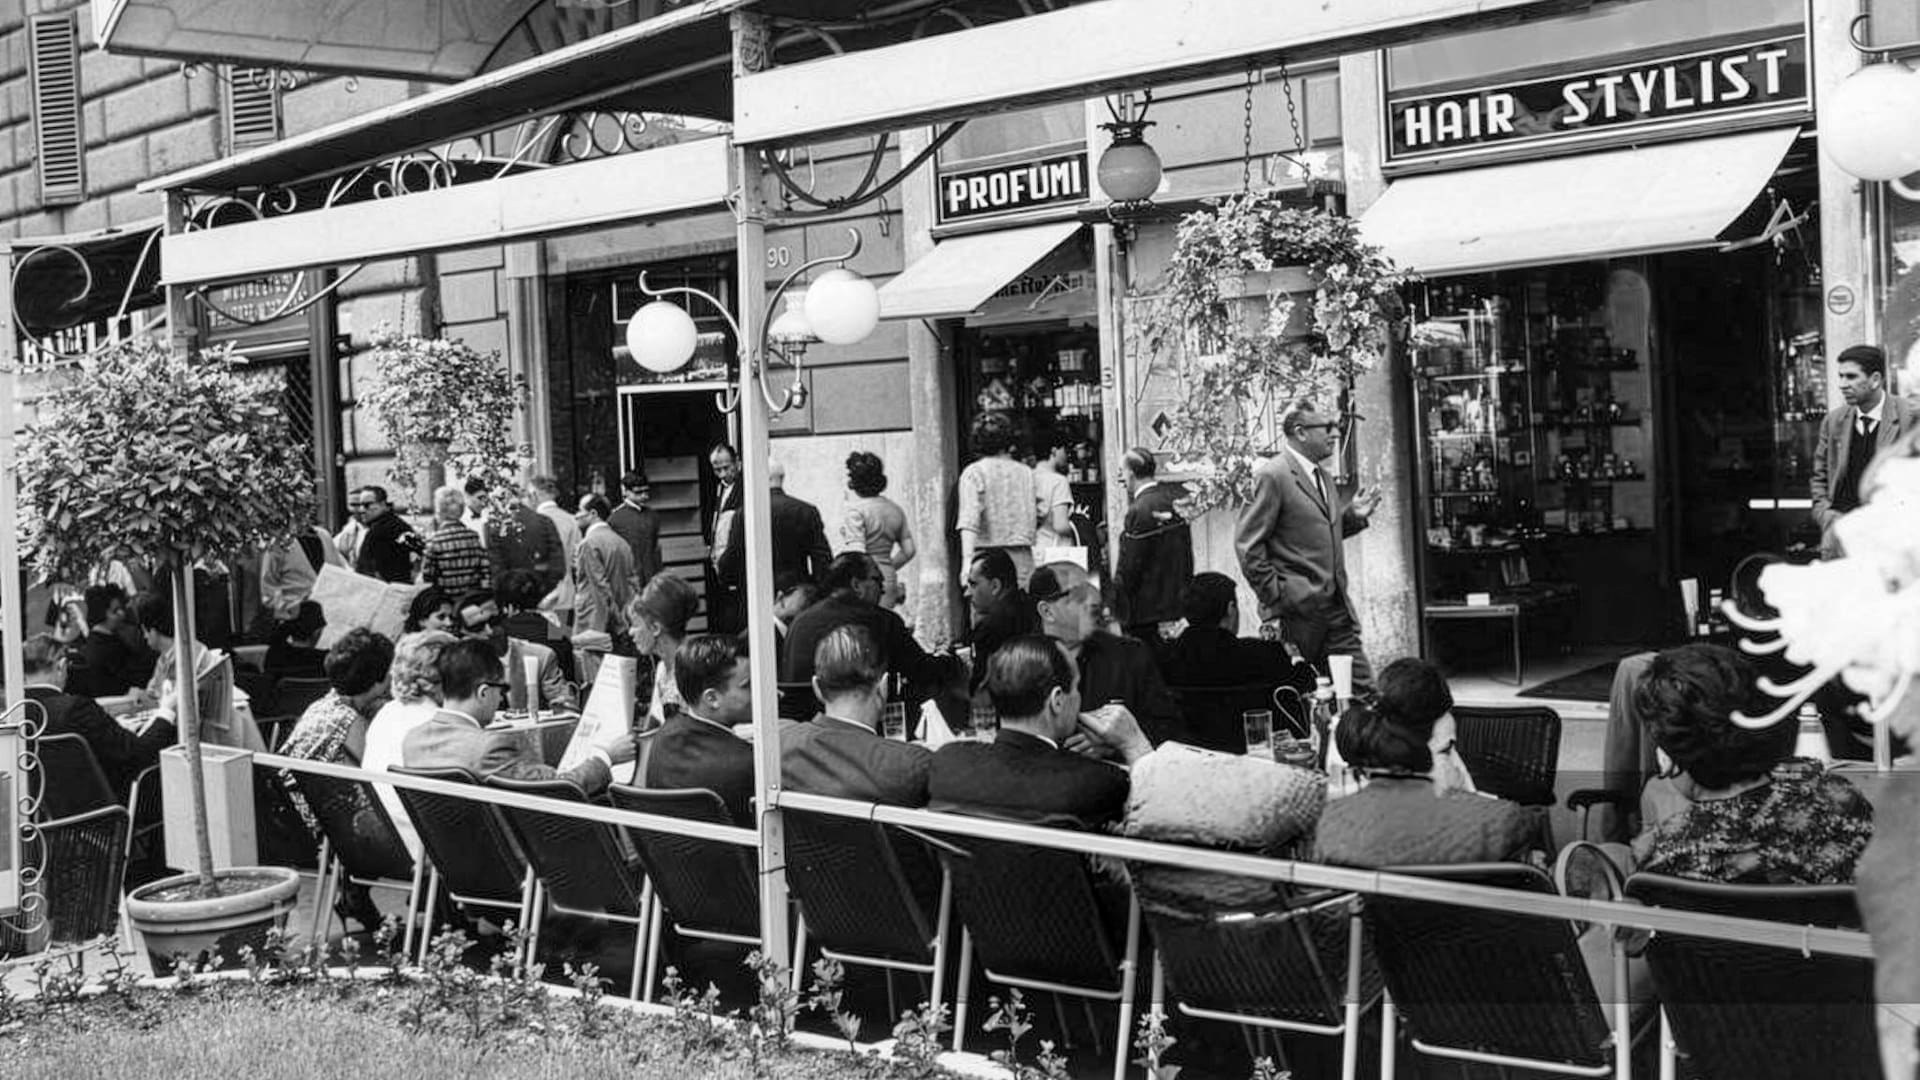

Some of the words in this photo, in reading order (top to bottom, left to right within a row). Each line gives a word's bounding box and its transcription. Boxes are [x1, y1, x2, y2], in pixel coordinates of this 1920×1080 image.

[1405, 93, 1515, 147] HAIR
[1562, 49, 1788, 124] STYLIST
[948, 160, 1081, 213] PROFUMI
[767, 246, 789, 268] 90
